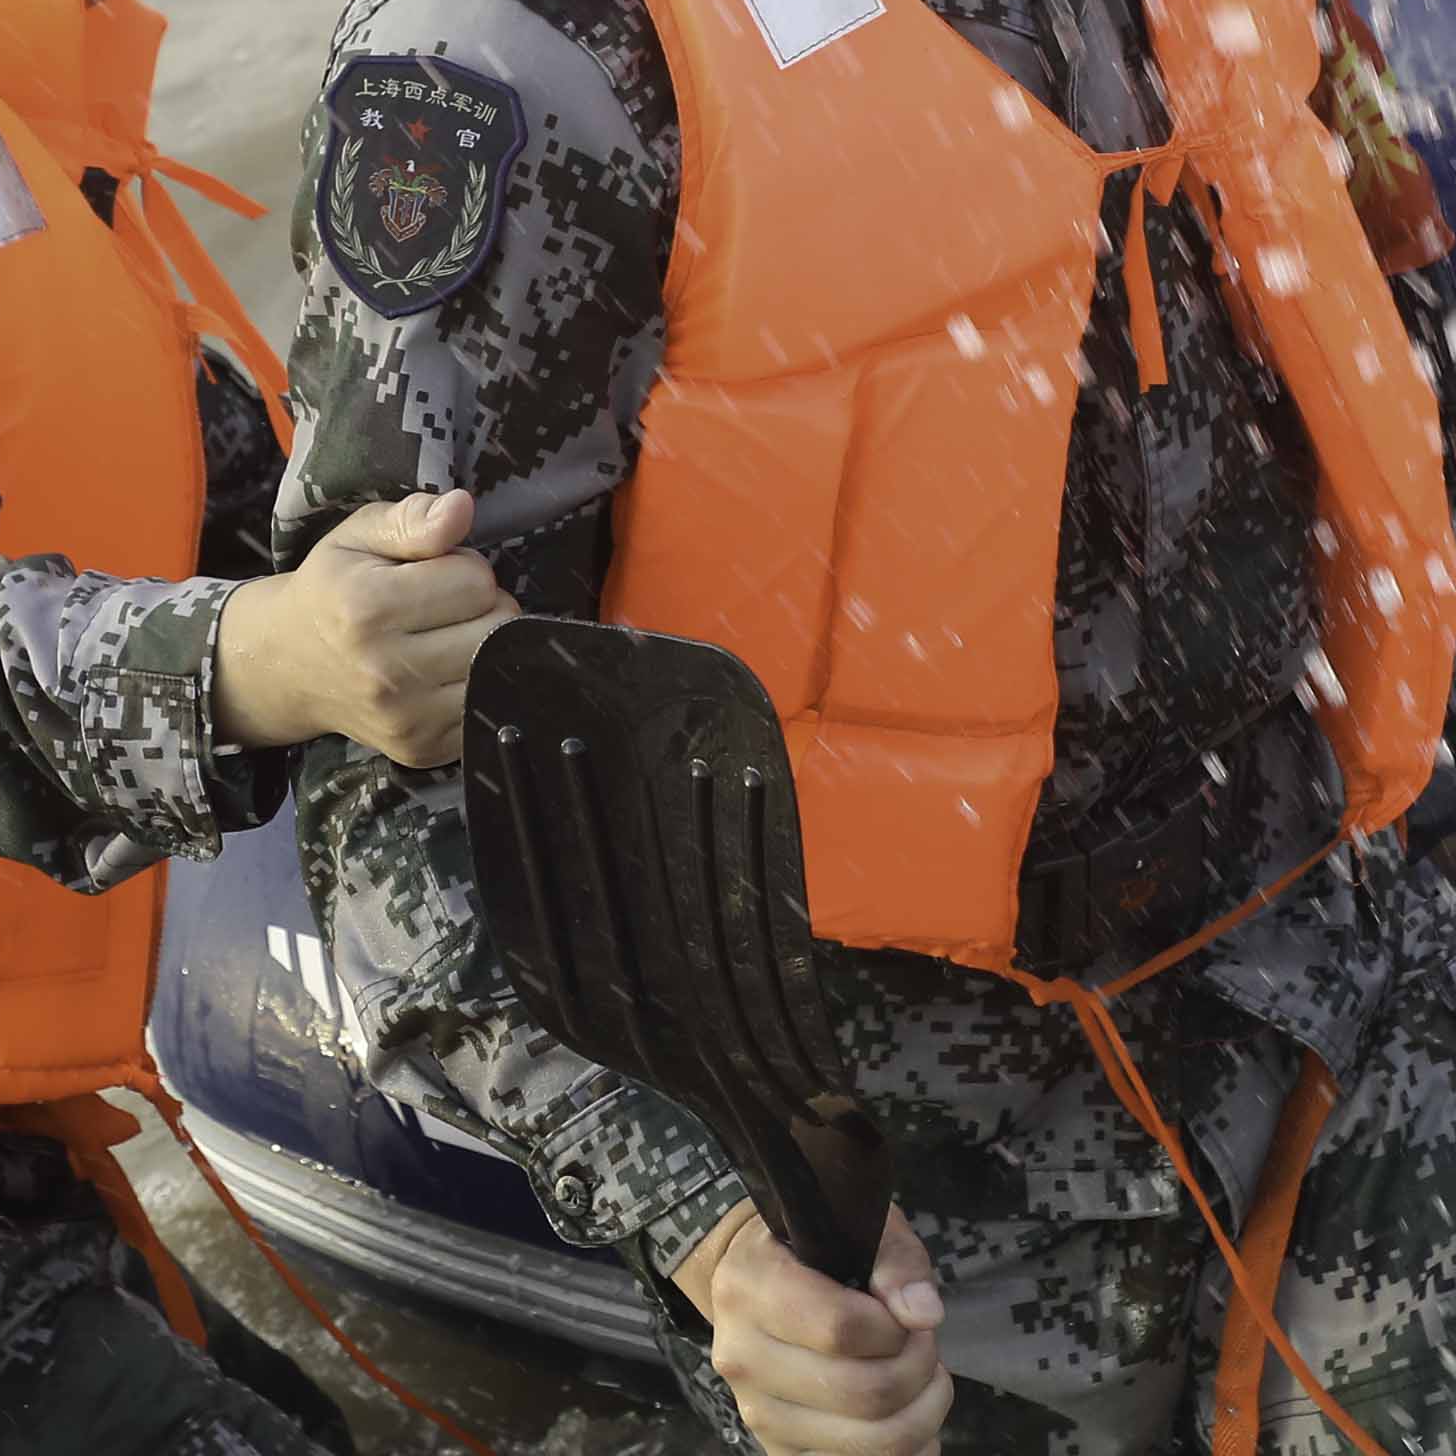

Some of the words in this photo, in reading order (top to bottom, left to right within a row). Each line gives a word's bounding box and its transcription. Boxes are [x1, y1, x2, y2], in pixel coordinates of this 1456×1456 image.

[355, 77, 499, 126] 上海西点军训
